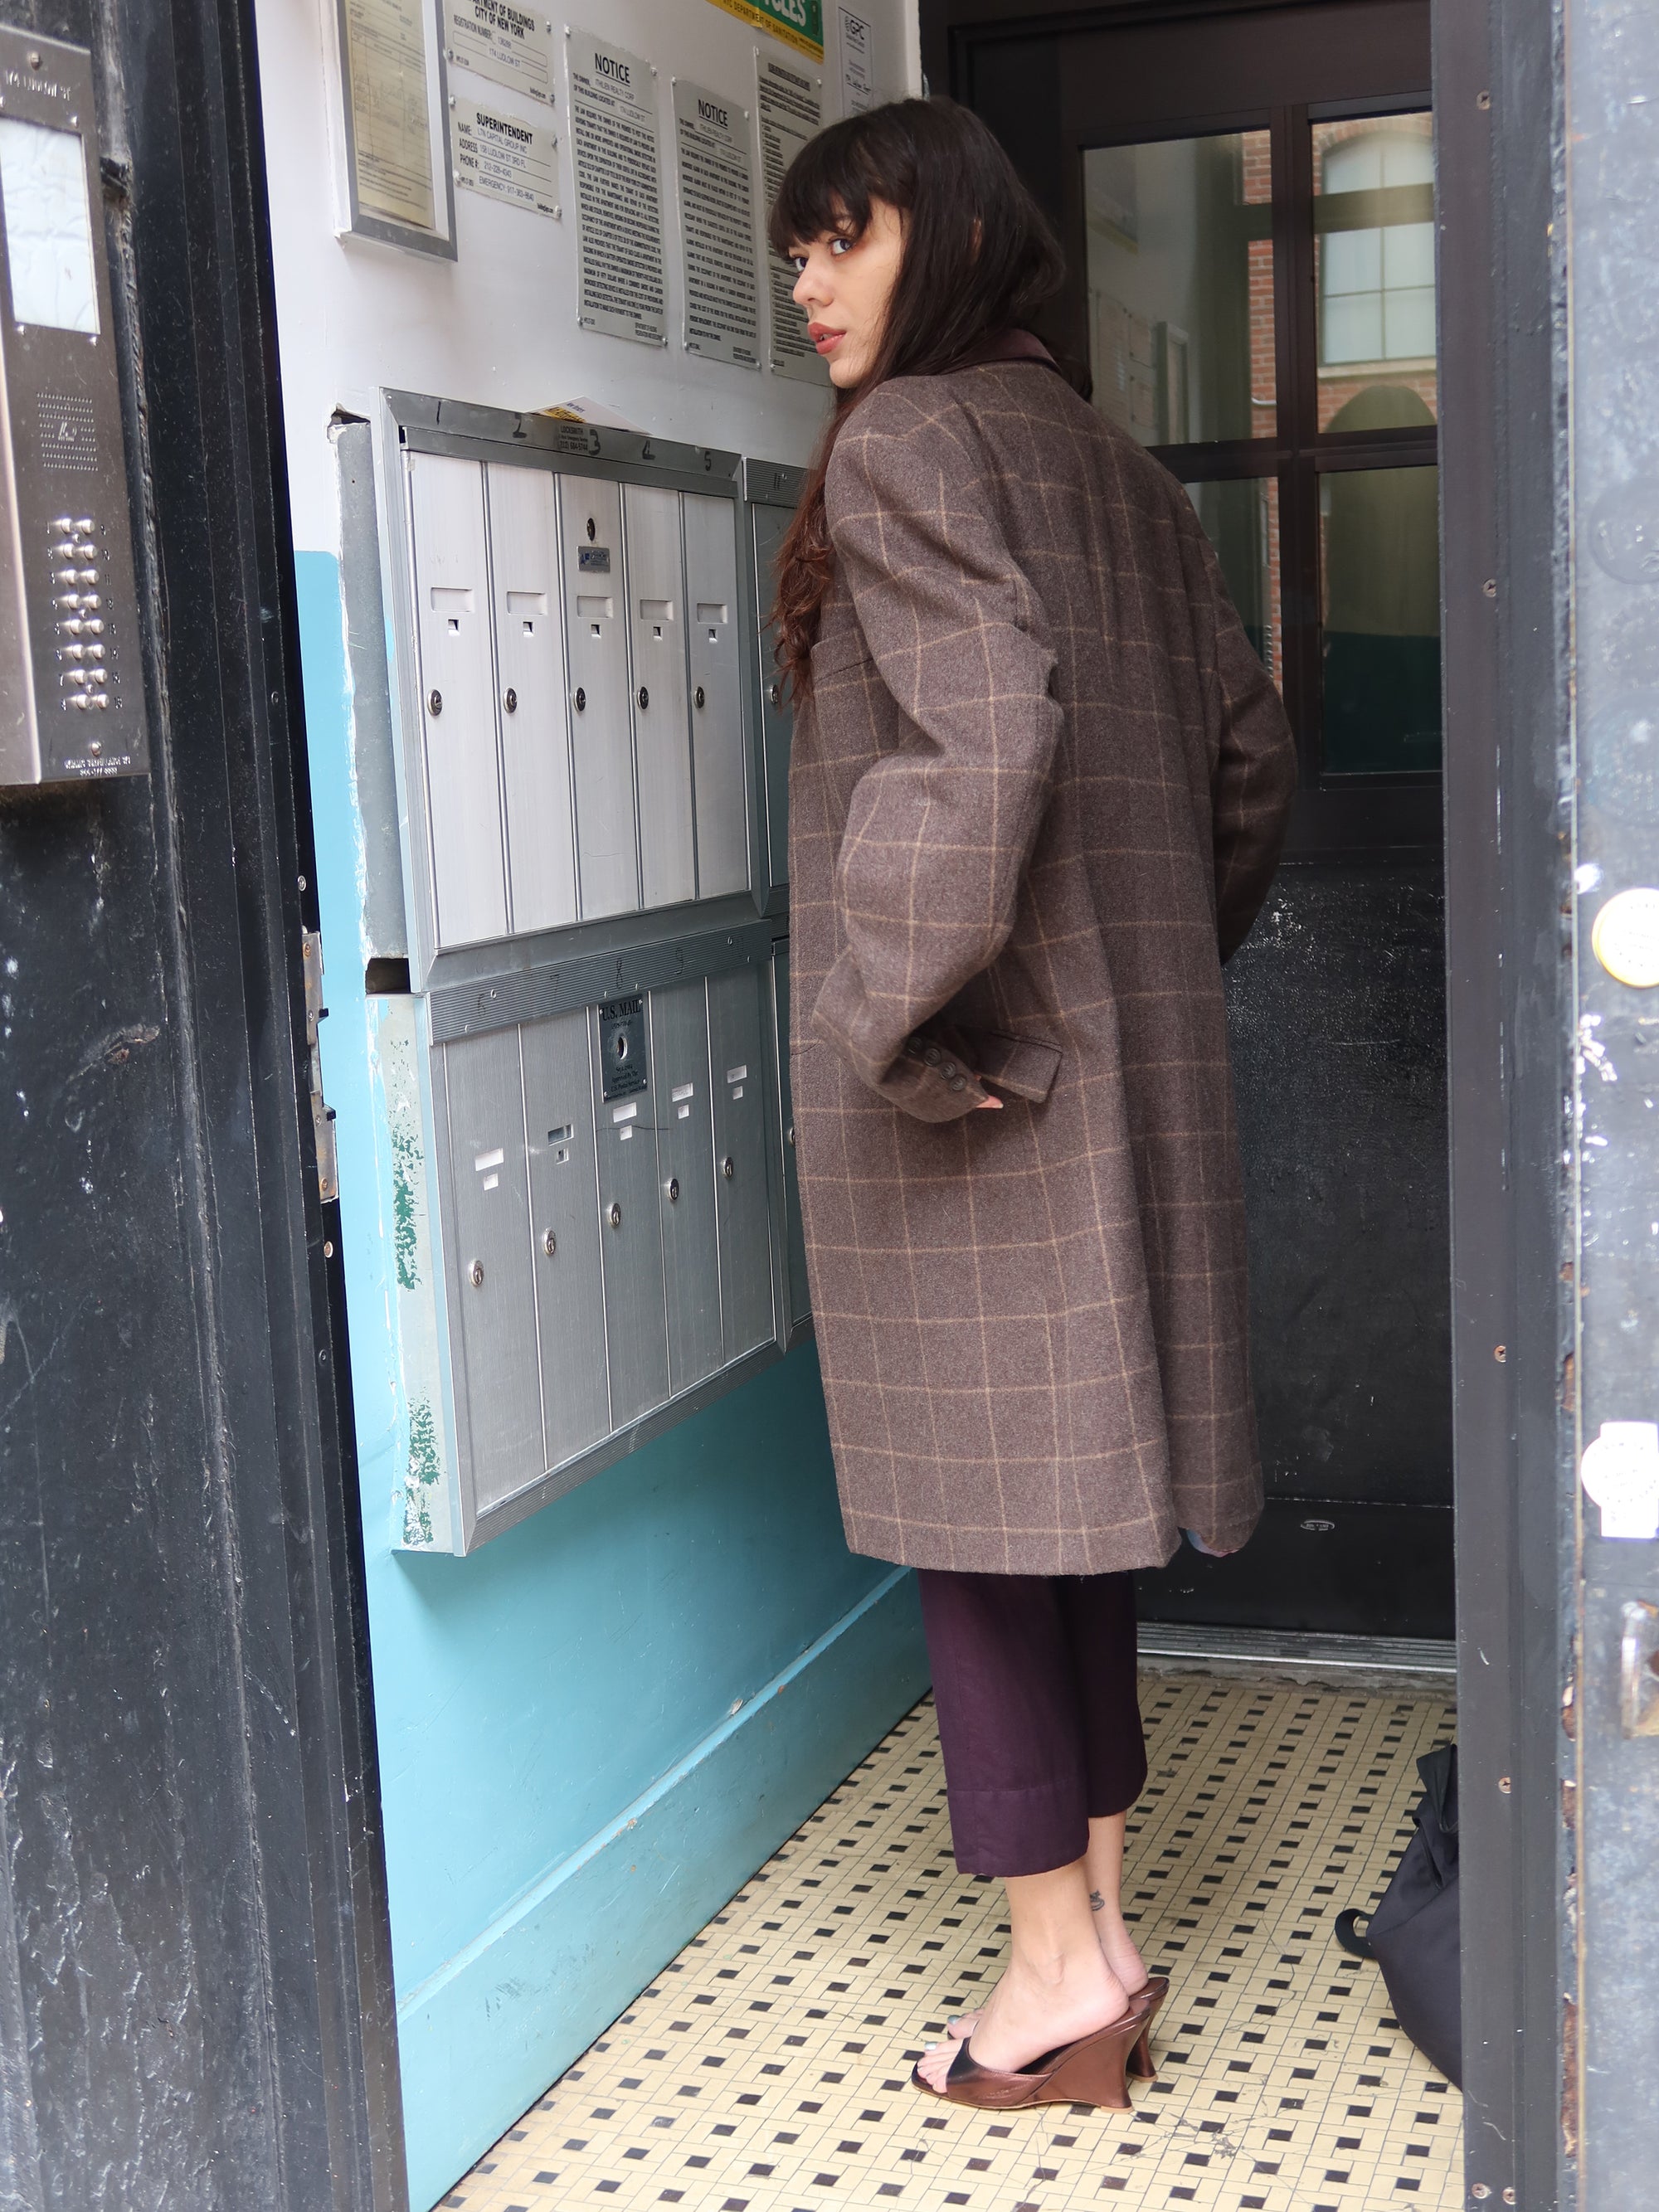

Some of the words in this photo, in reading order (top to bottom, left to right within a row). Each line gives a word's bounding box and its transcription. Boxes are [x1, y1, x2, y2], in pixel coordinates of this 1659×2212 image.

[474, 5, 488, 22] CITY
[489, 12, 496, 26] OF
[498, 16, 509, 32] NEW
[510, 22, 525, 40] YORK
[499, 3, 506, 17] OF
[507, 7, 535, 32] BUILDINGS
[514, 59, 521, 67] ST
[595, 52, 630, 84] NOTICE
[698, 99, 728, 127] NOTICE
[476, 112, 533, 145] SUPERINTENDENT
[460, 153, 474, 168] PHONE
[436, 401, 442, 425] 1
[512, 413, 528, 439] 2
[560, 425, 584, 435] LOCKSMITH
[588, 429, 601, 456] 3
[642, 440, 656, 460] 4
[703, 450, 713, 472] 5
[602, 1004, 618, 1021] U.S.
[619, 999, 641, 1018] MAIL
